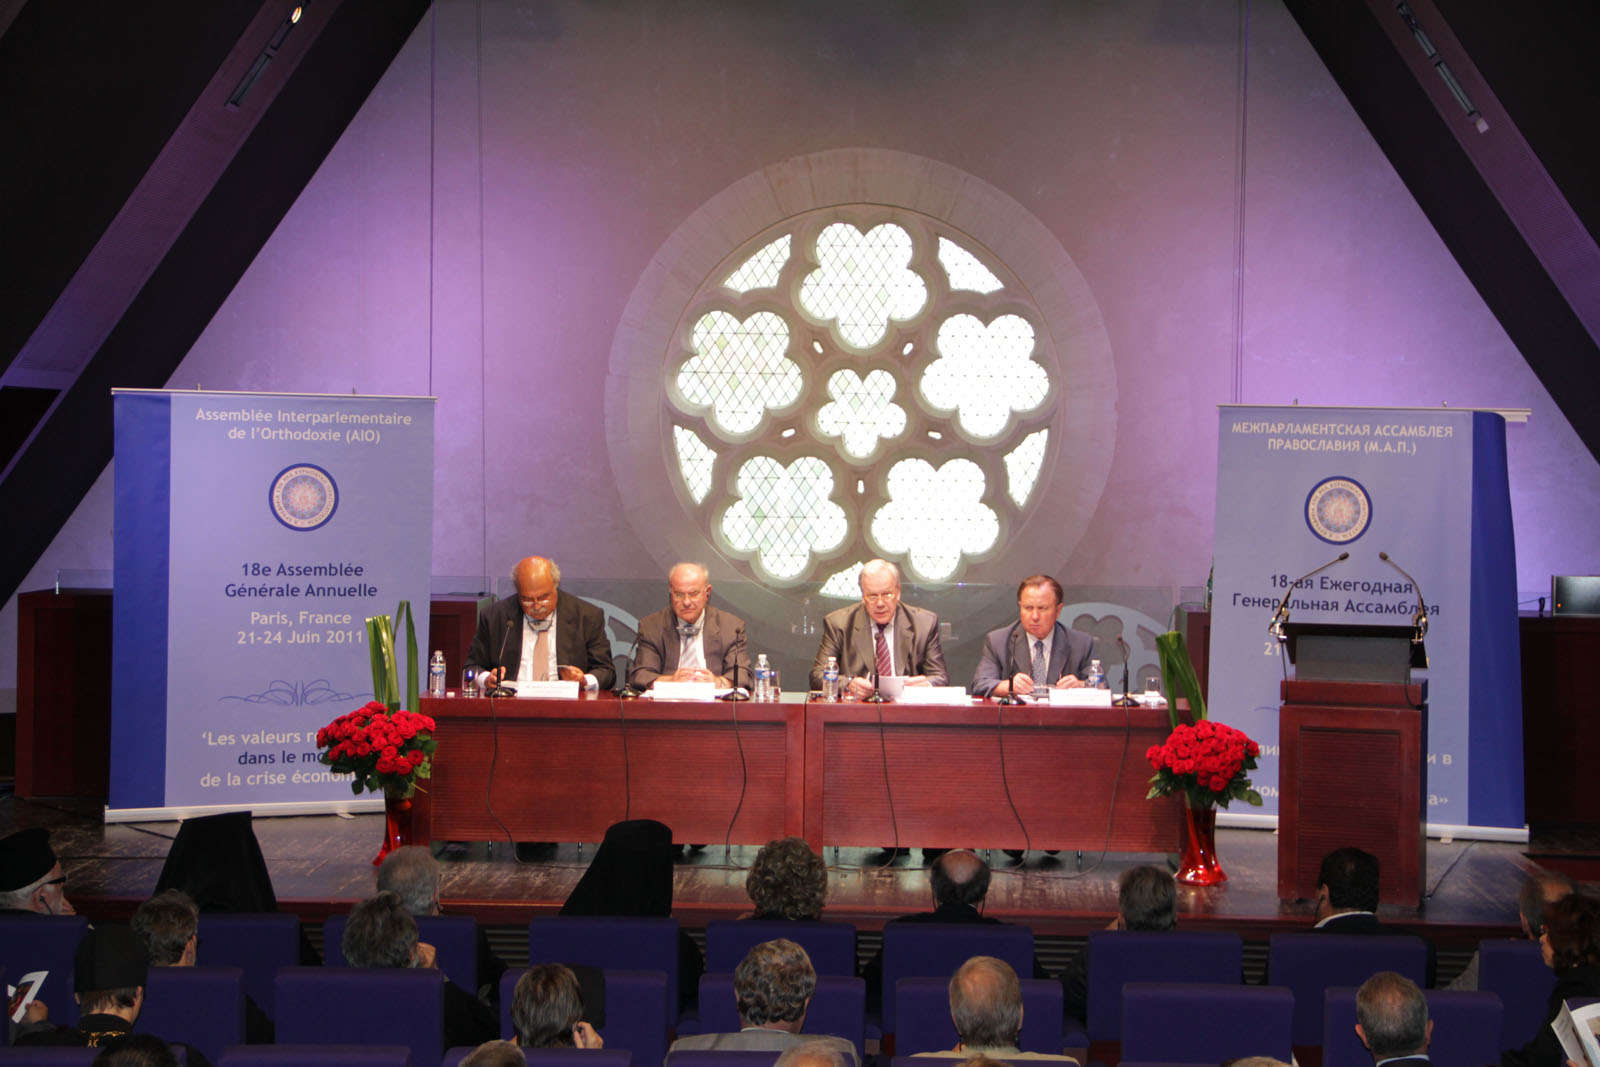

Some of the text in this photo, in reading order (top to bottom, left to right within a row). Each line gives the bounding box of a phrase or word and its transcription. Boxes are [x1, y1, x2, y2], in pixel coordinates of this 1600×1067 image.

[195, 408, 413, 426] Assemblée Interparlementaire
[228, 426, 247, 440] de
[345, 430, 381, 445] (AIO)
[1231, 422, 1453, 439] МЕЖПАРЛАМЕНТСКАЯ АССАМБЛЕЯ
[1267, 438, 1417, 456] ПРАВОСЛАВИЯ (М.А.П.)
[241, 562, 364, 577] 18e Assemblée
[224, 583, 378, 598] Générale Annuelle
[1271, 574, 1413, 595] 18-ая Ежегодная
[250, 611, 352, 627] Paris, France
[236, 630, 363, 645] 21-24 Juin 2011
[240, 731, 301, 745] valeurs
[237, 751, 275, 766] dans
[281, 750, 297, 764] le
[199, 772, 222, 788] de
[227, 771, 242, 786] la
[246, 770, 287, 785] crise
